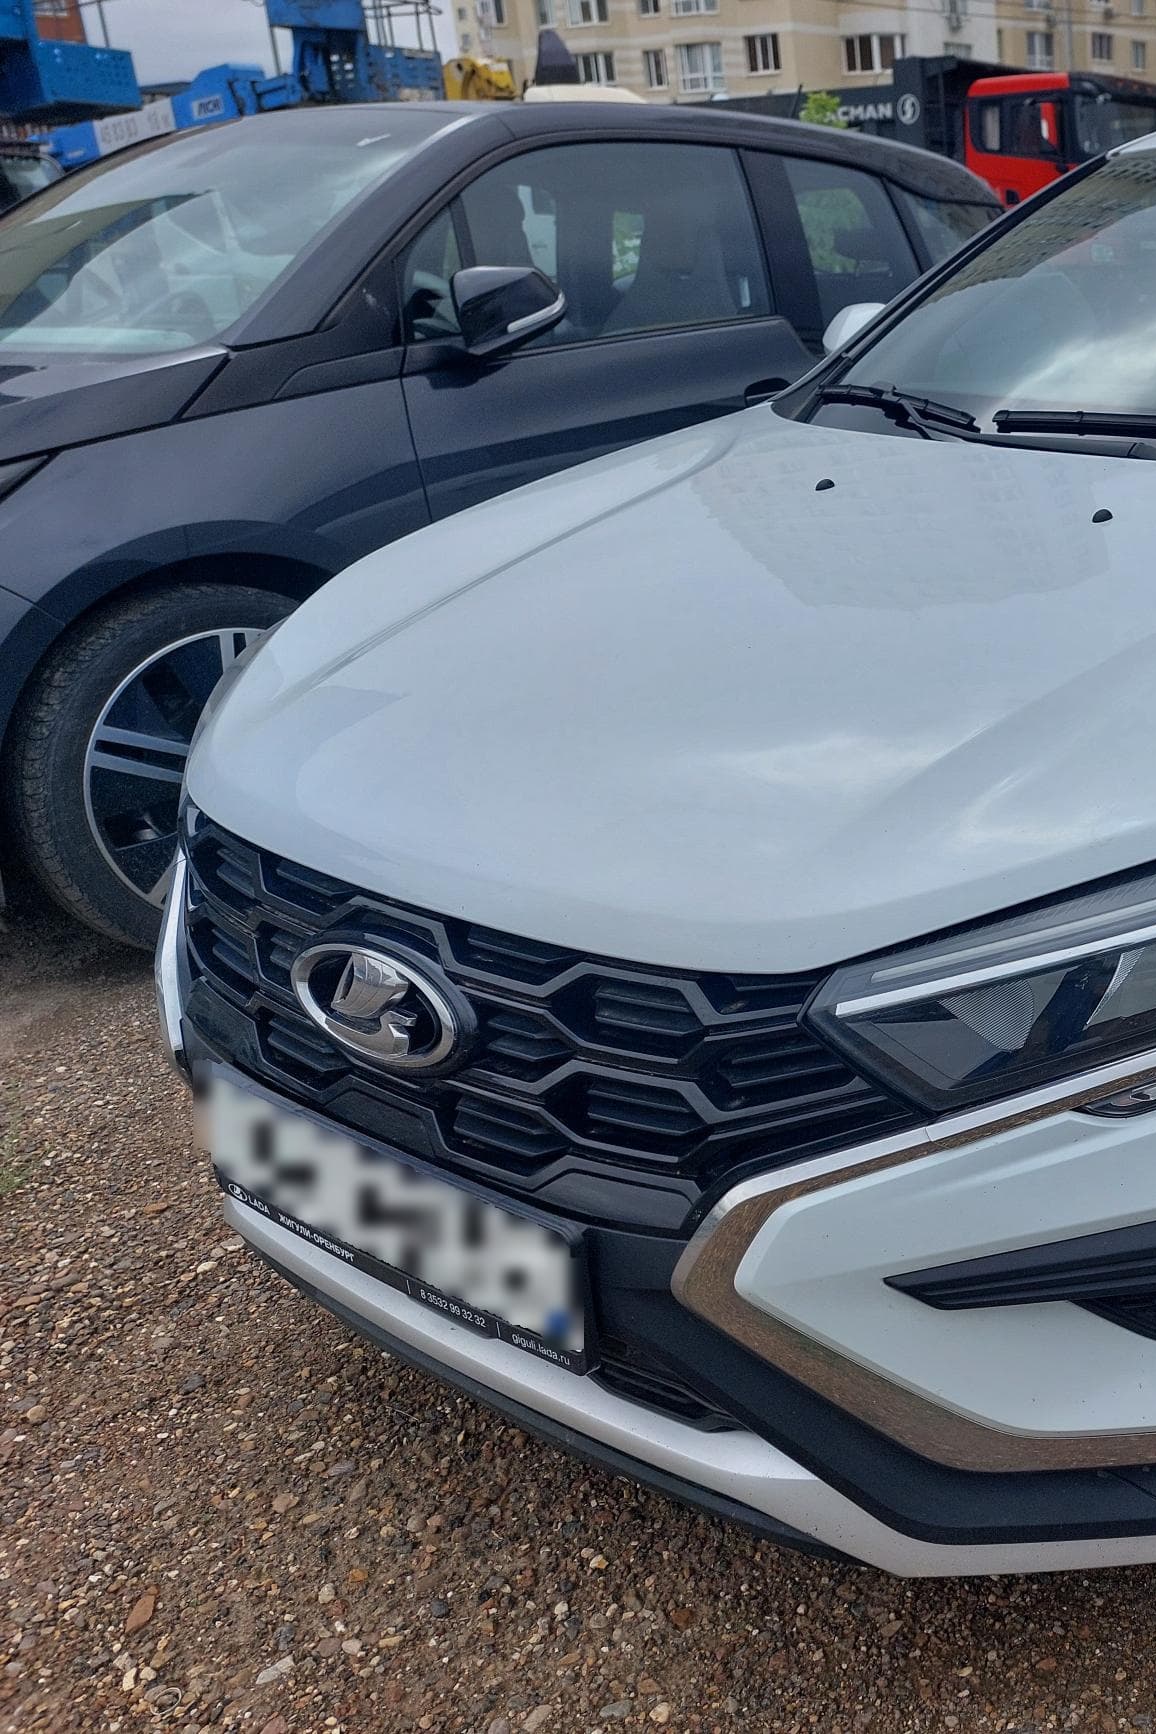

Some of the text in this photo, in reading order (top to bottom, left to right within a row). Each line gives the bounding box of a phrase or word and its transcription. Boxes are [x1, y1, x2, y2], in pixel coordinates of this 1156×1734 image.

[824, 102, 893, 122] CMAN
[248, 1195, 271, 1216] LADA
[278, 1212, 355, 1262] ЖИГУЛИ-ОРЕНБУРГ
[420, 1289, 487, 1328] 8 3532 99 32 32
[511, 1333, 570, 1366] giguli.lada.ru
